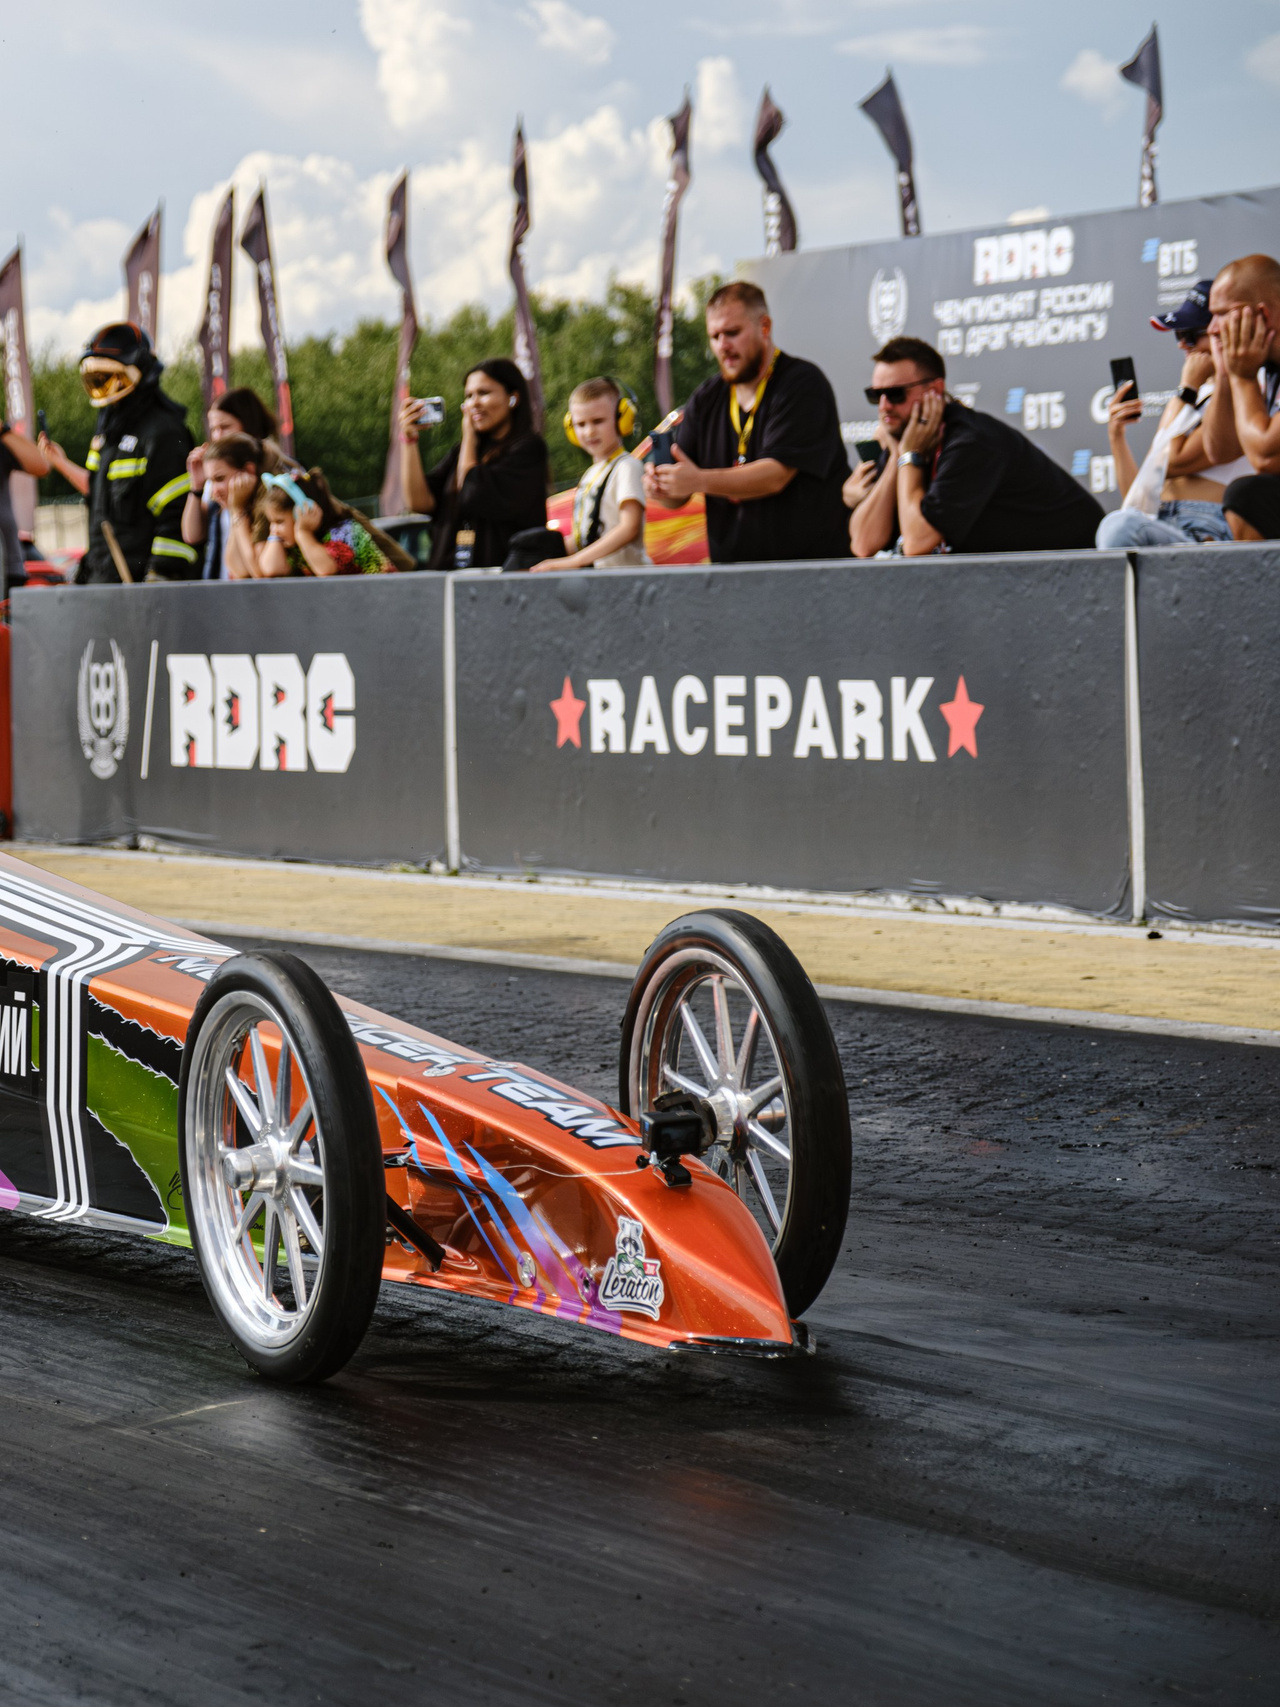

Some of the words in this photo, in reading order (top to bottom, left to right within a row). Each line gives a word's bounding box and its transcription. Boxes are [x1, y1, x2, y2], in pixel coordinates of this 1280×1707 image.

[973, 226, 1075, 286] RDRC
[1158, 239, 1199, 279] ВТБ
[1038, 280, 1115, 318] РОССИИ
[936, 327, 964, 356] ПО
[1023, 391, 1067, 431] ВТБ
[1090, 454, 1117, 494] ВТ
[166, 653, 356, 773] RDRC
[586, 674, 938, 763] RACEPARK
[467, 1067, 642, 1147] TEAM
